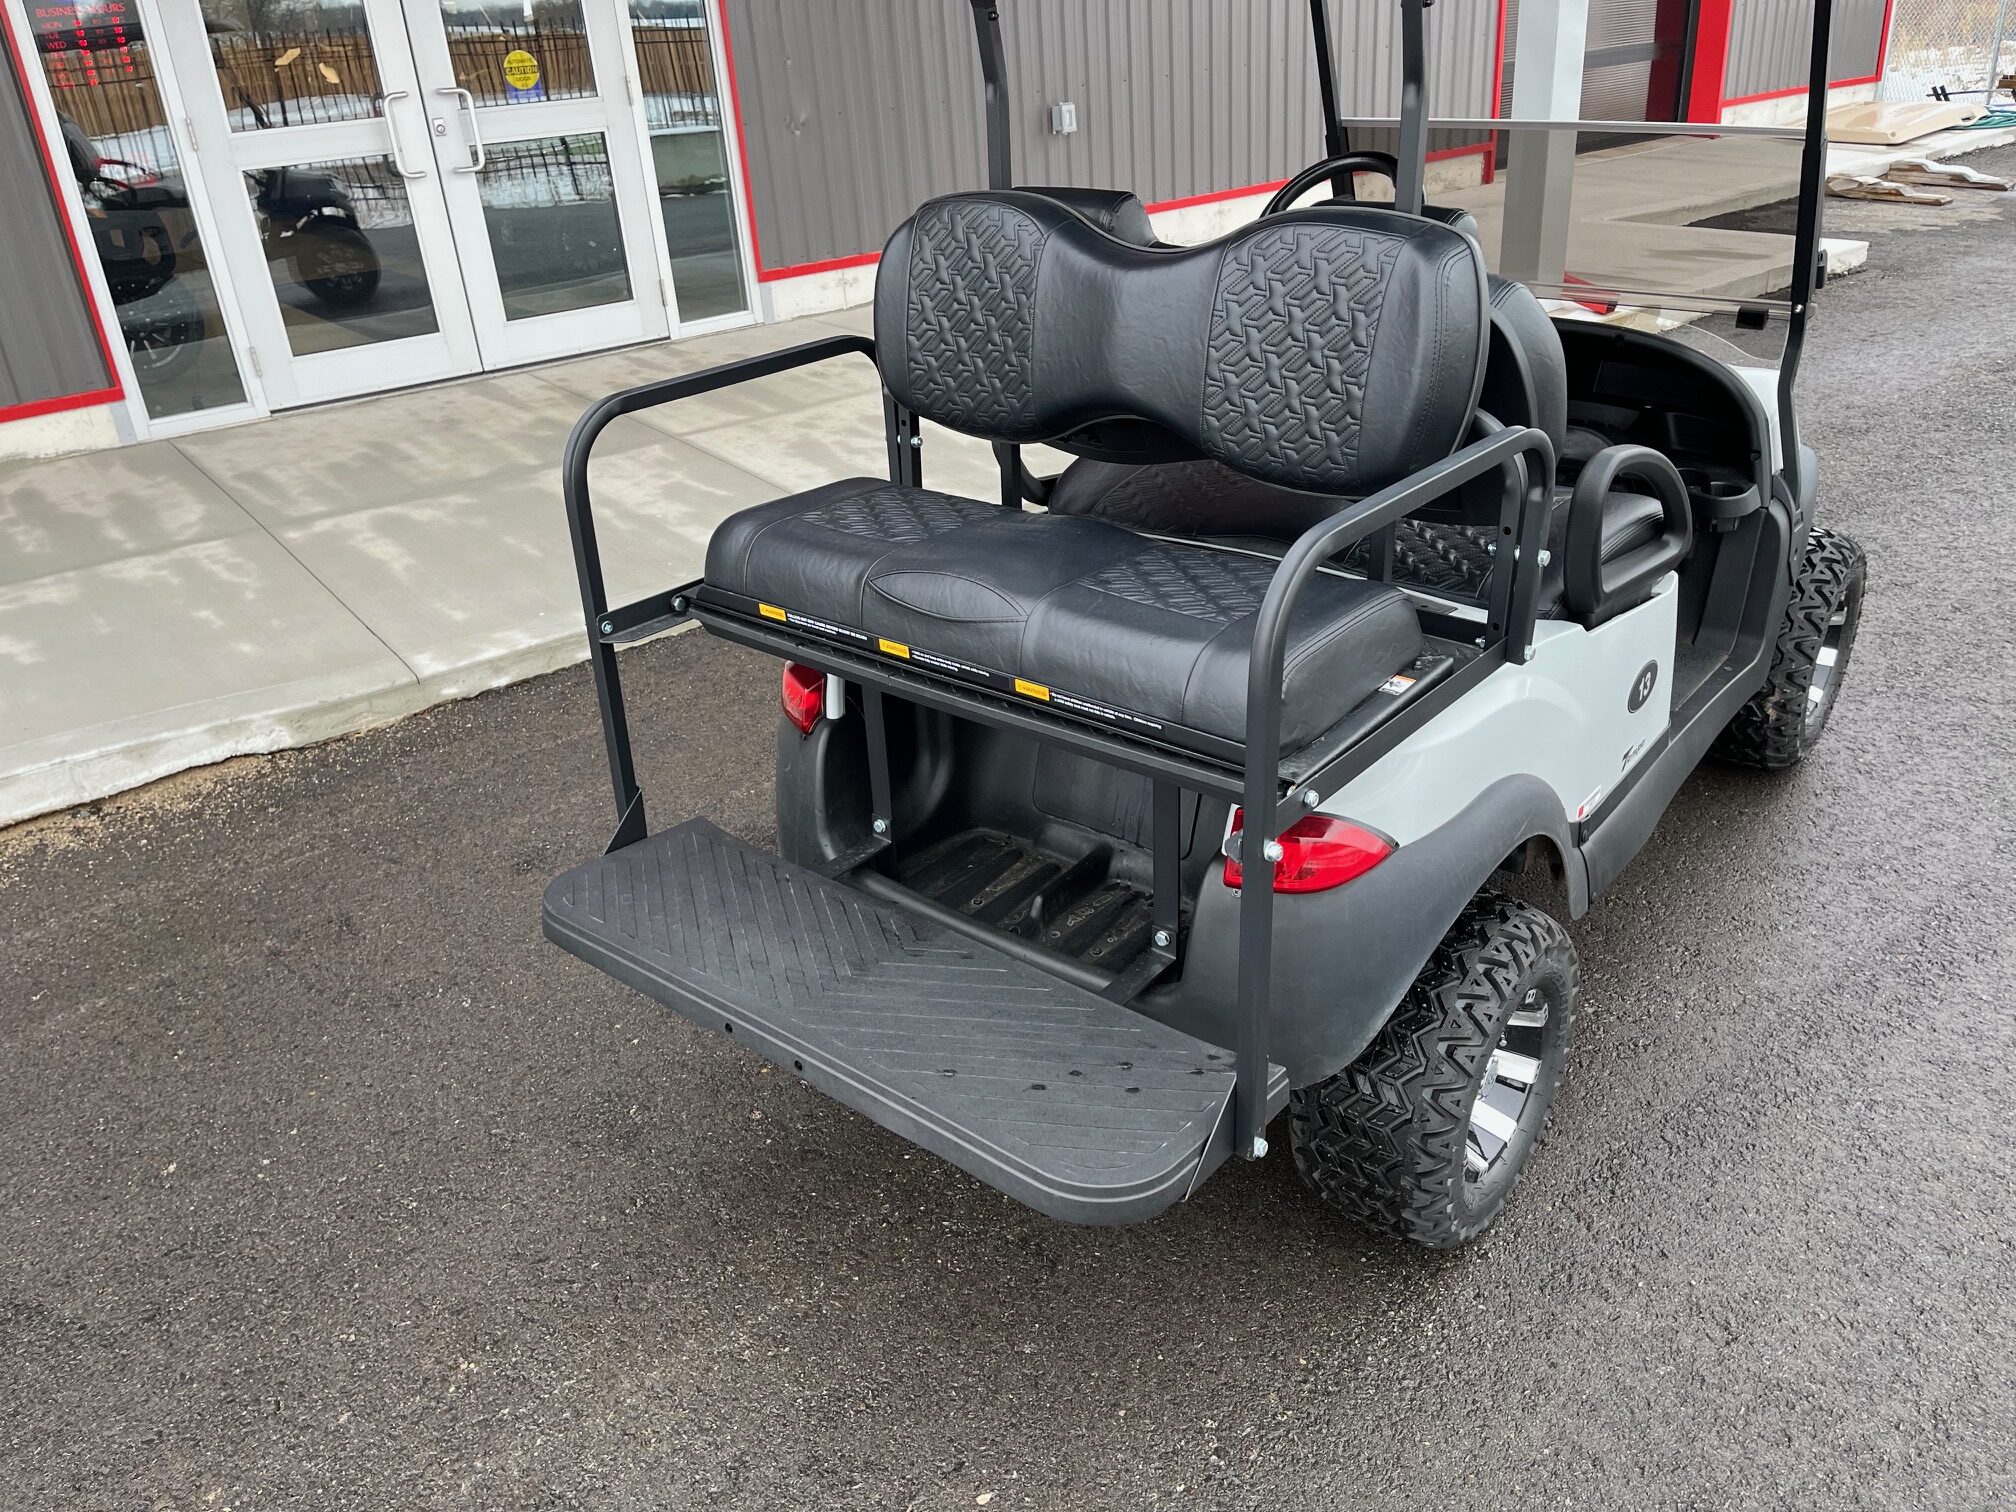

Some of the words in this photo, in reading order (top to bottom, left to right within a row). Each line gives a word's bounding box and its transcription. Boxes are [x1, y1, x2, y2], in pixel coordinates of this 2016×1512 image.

[47, 41, 67, 49] WED
[506, 66, 537, 75] CAUTION
[1022, 685, 1047, 697] WARNING
[1638, 671, 1652, 701] 13
